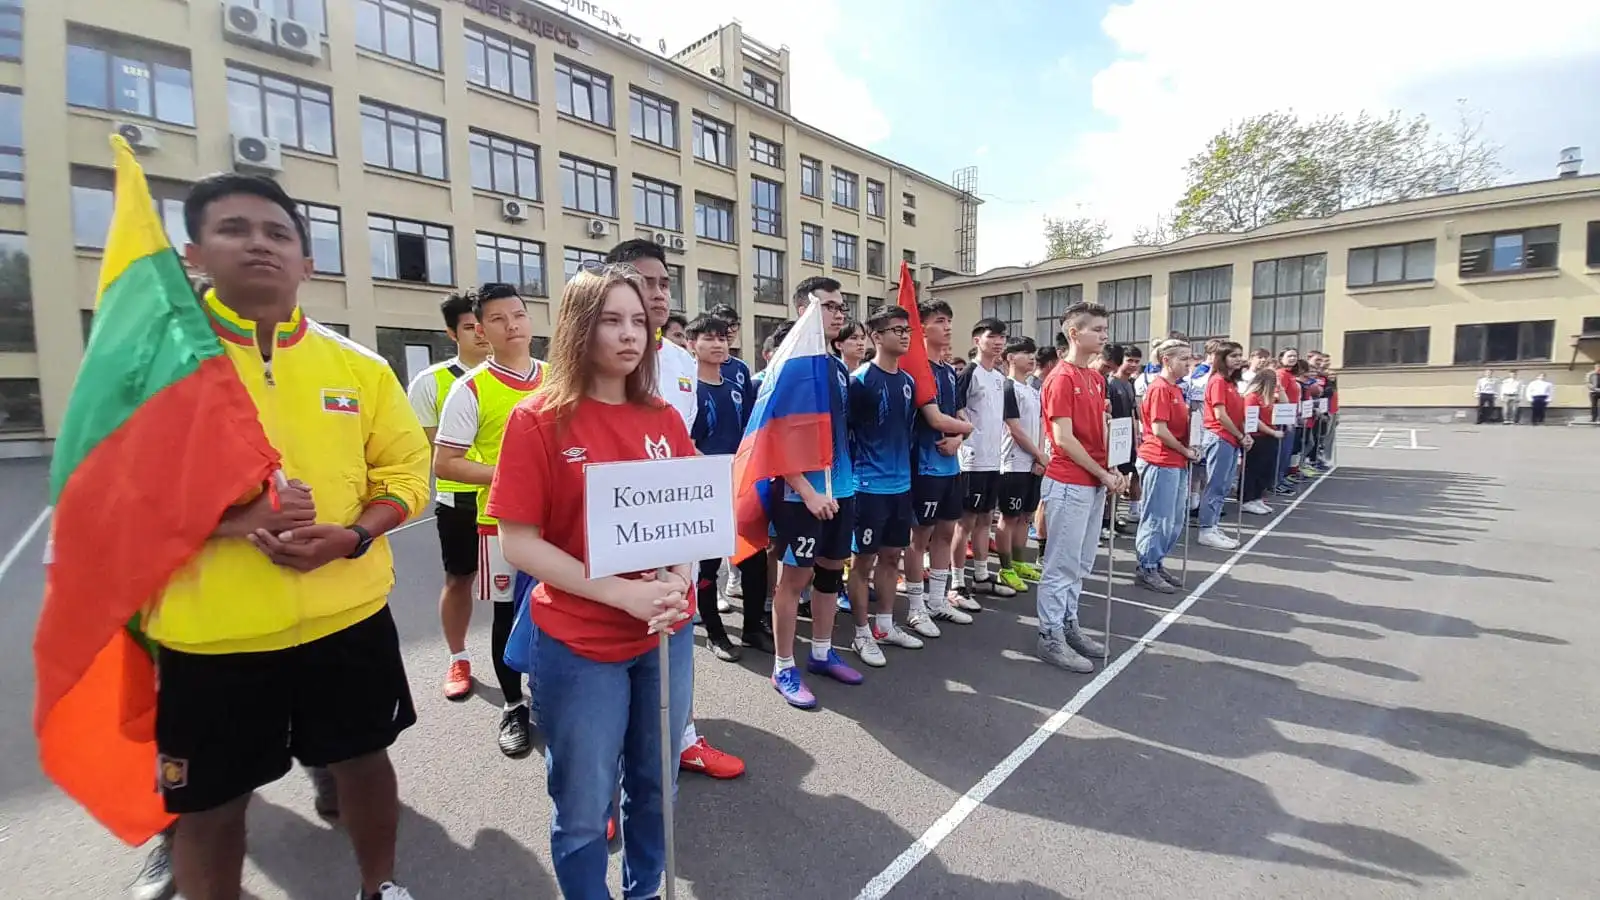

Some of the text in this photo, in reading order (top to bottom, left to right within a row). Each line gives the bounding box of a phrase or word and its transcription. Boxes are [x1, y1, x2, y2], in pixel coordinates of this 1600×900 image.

[516, 11, 579, 49] ЗДЕСЬ
[613, 483, 714, 508] Команда
[974, 493, 981, 508] 7
[1009, 497, 1022, 511] 30
[923, 501, 938, 518] 77
[613, 519, 714, 545] Мьянмы
[862, 528, 873, 545] 8
[795, 536, 816, 558] 22
